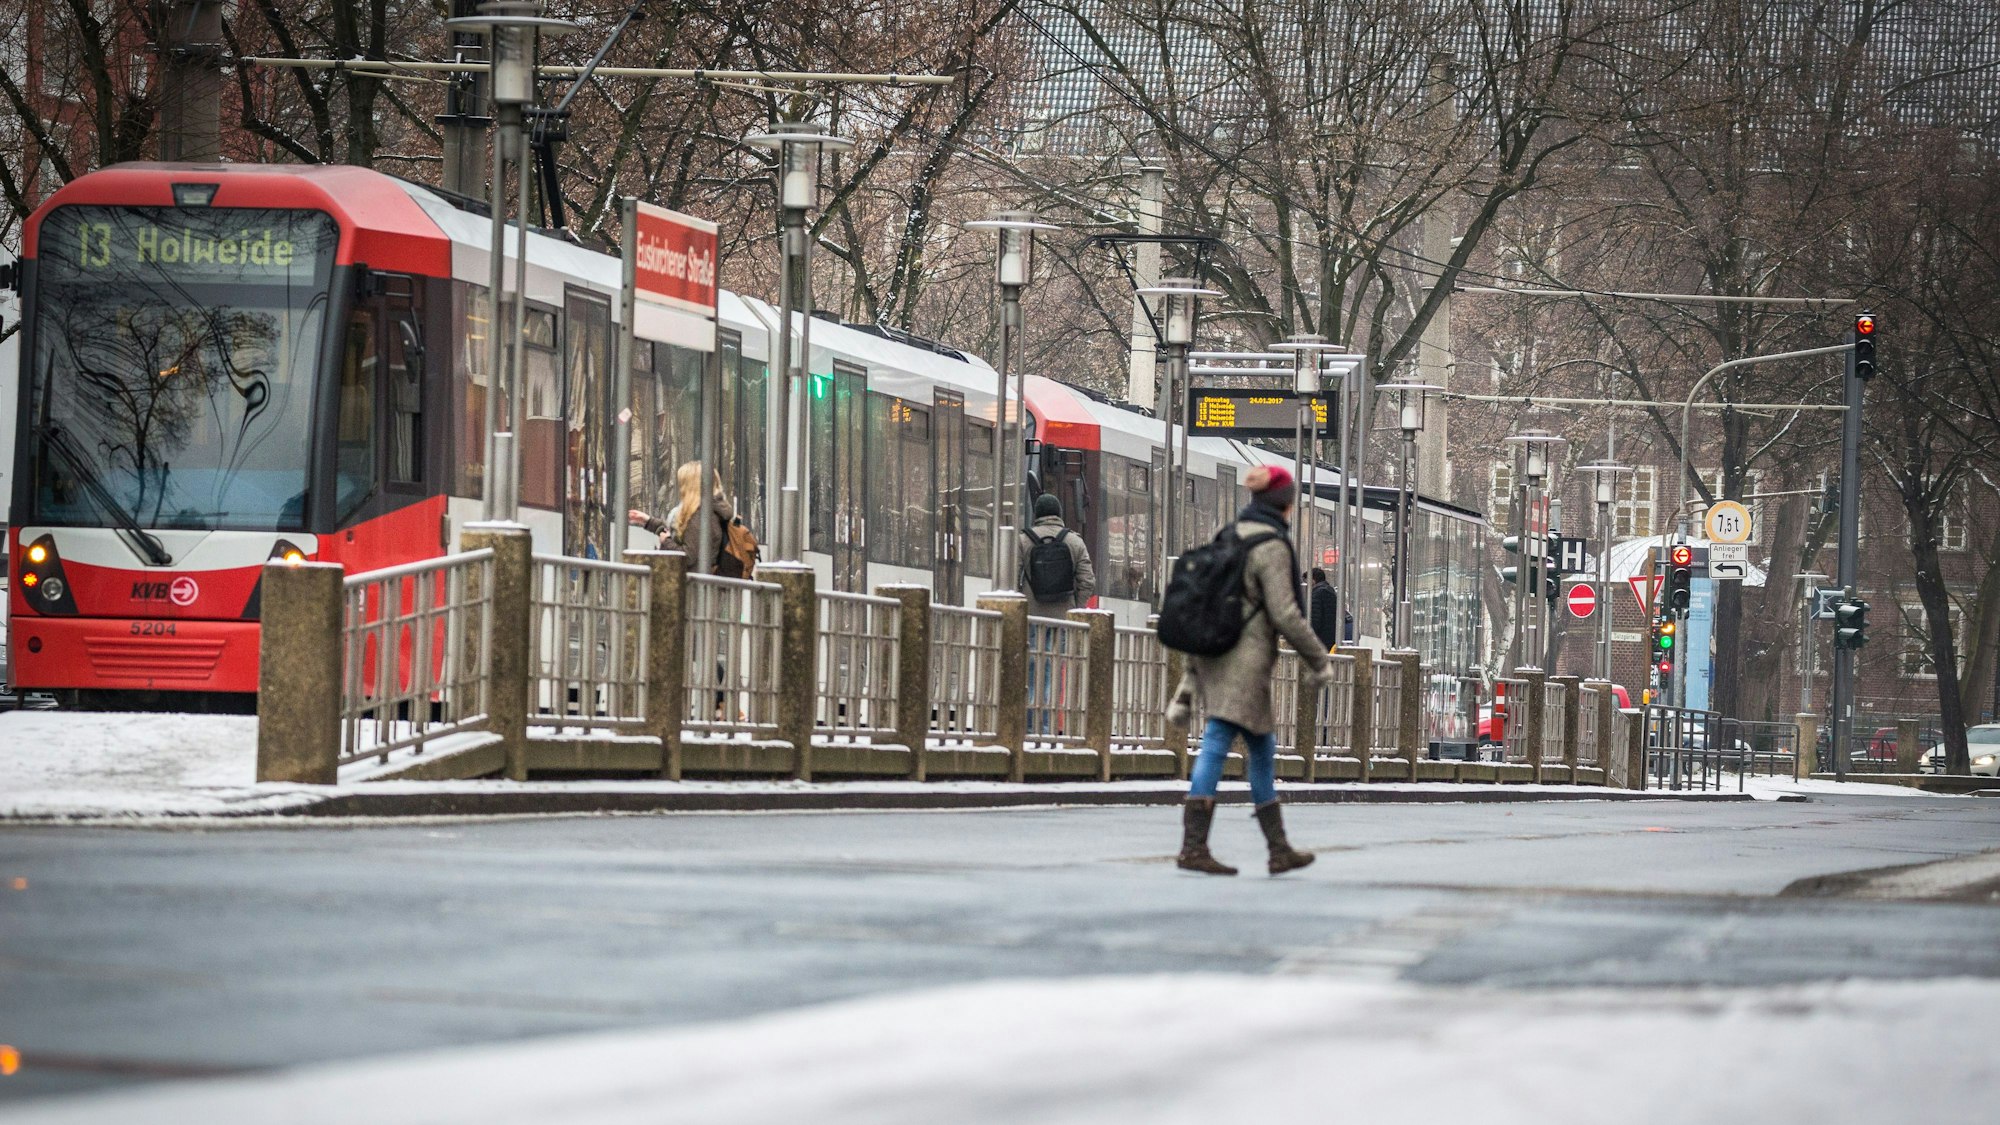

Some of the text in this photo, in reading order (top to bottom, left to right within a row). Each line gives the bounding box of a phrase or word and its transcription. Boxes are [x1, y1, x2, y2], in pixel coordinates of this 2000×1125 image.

[79, 223, 293, 267] 13 Holweide
[636, 231, 715, 287] Euskirchener Straße
[1249, 397, 1284, 405] 24.01.2017
[1717, 514, 1732, 534] 7,5
[1561, 540, 1583, 571] H
[1713, 545, 1743, 553] Anlieger
[130, 582, 168, 599] KVB
[130, 621, 177, 637] 5204
